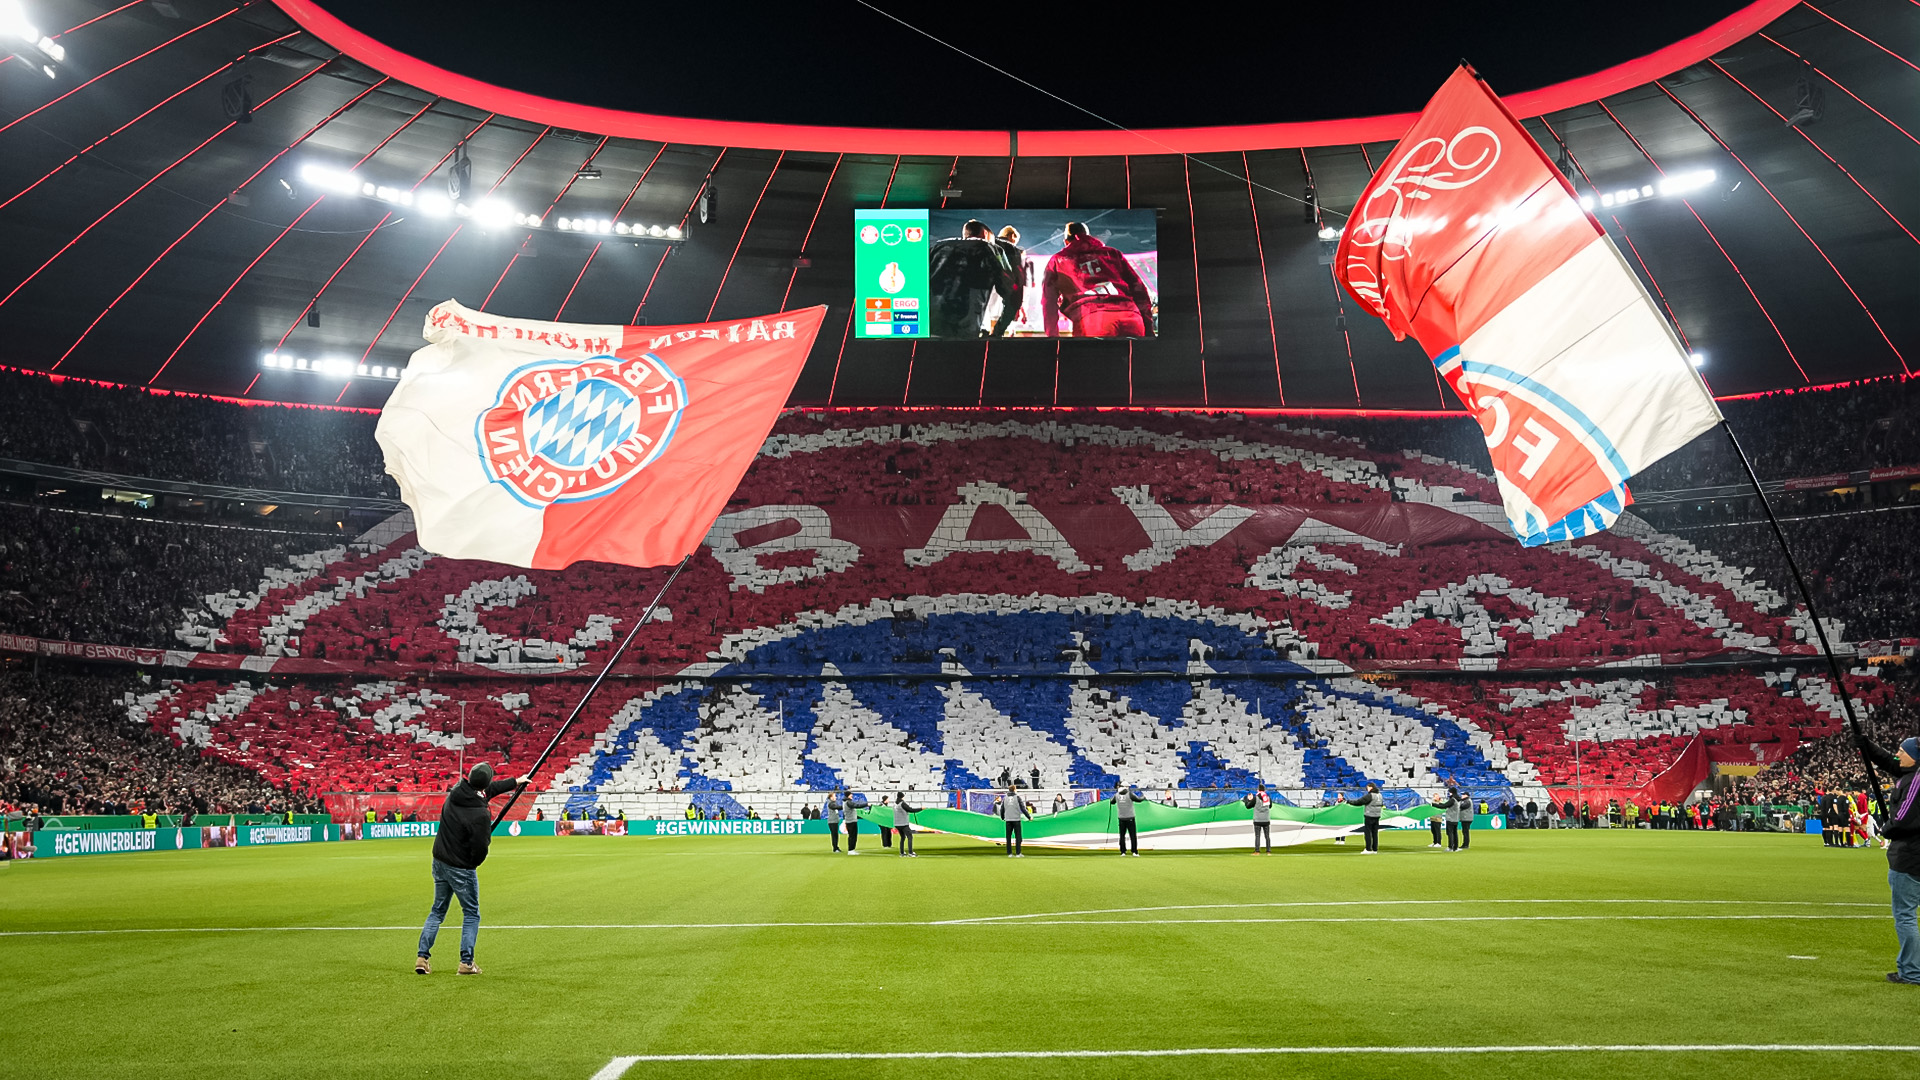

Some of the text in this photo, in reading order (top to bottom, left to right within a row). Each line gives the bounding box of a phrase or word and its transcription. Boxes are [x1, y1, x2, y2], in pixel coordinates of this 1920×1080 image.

[86, 646, 136, 661] SENZIG
[250, 826, 312, 844] #GEWINNERBLEIBT
[370, 822, 438, 838] #GEWINNERBL
[655, 820, 805, 835] #GEWINNERBLEIBT
[54, 831, 156, 854] #GEWINNERBLEIBT
